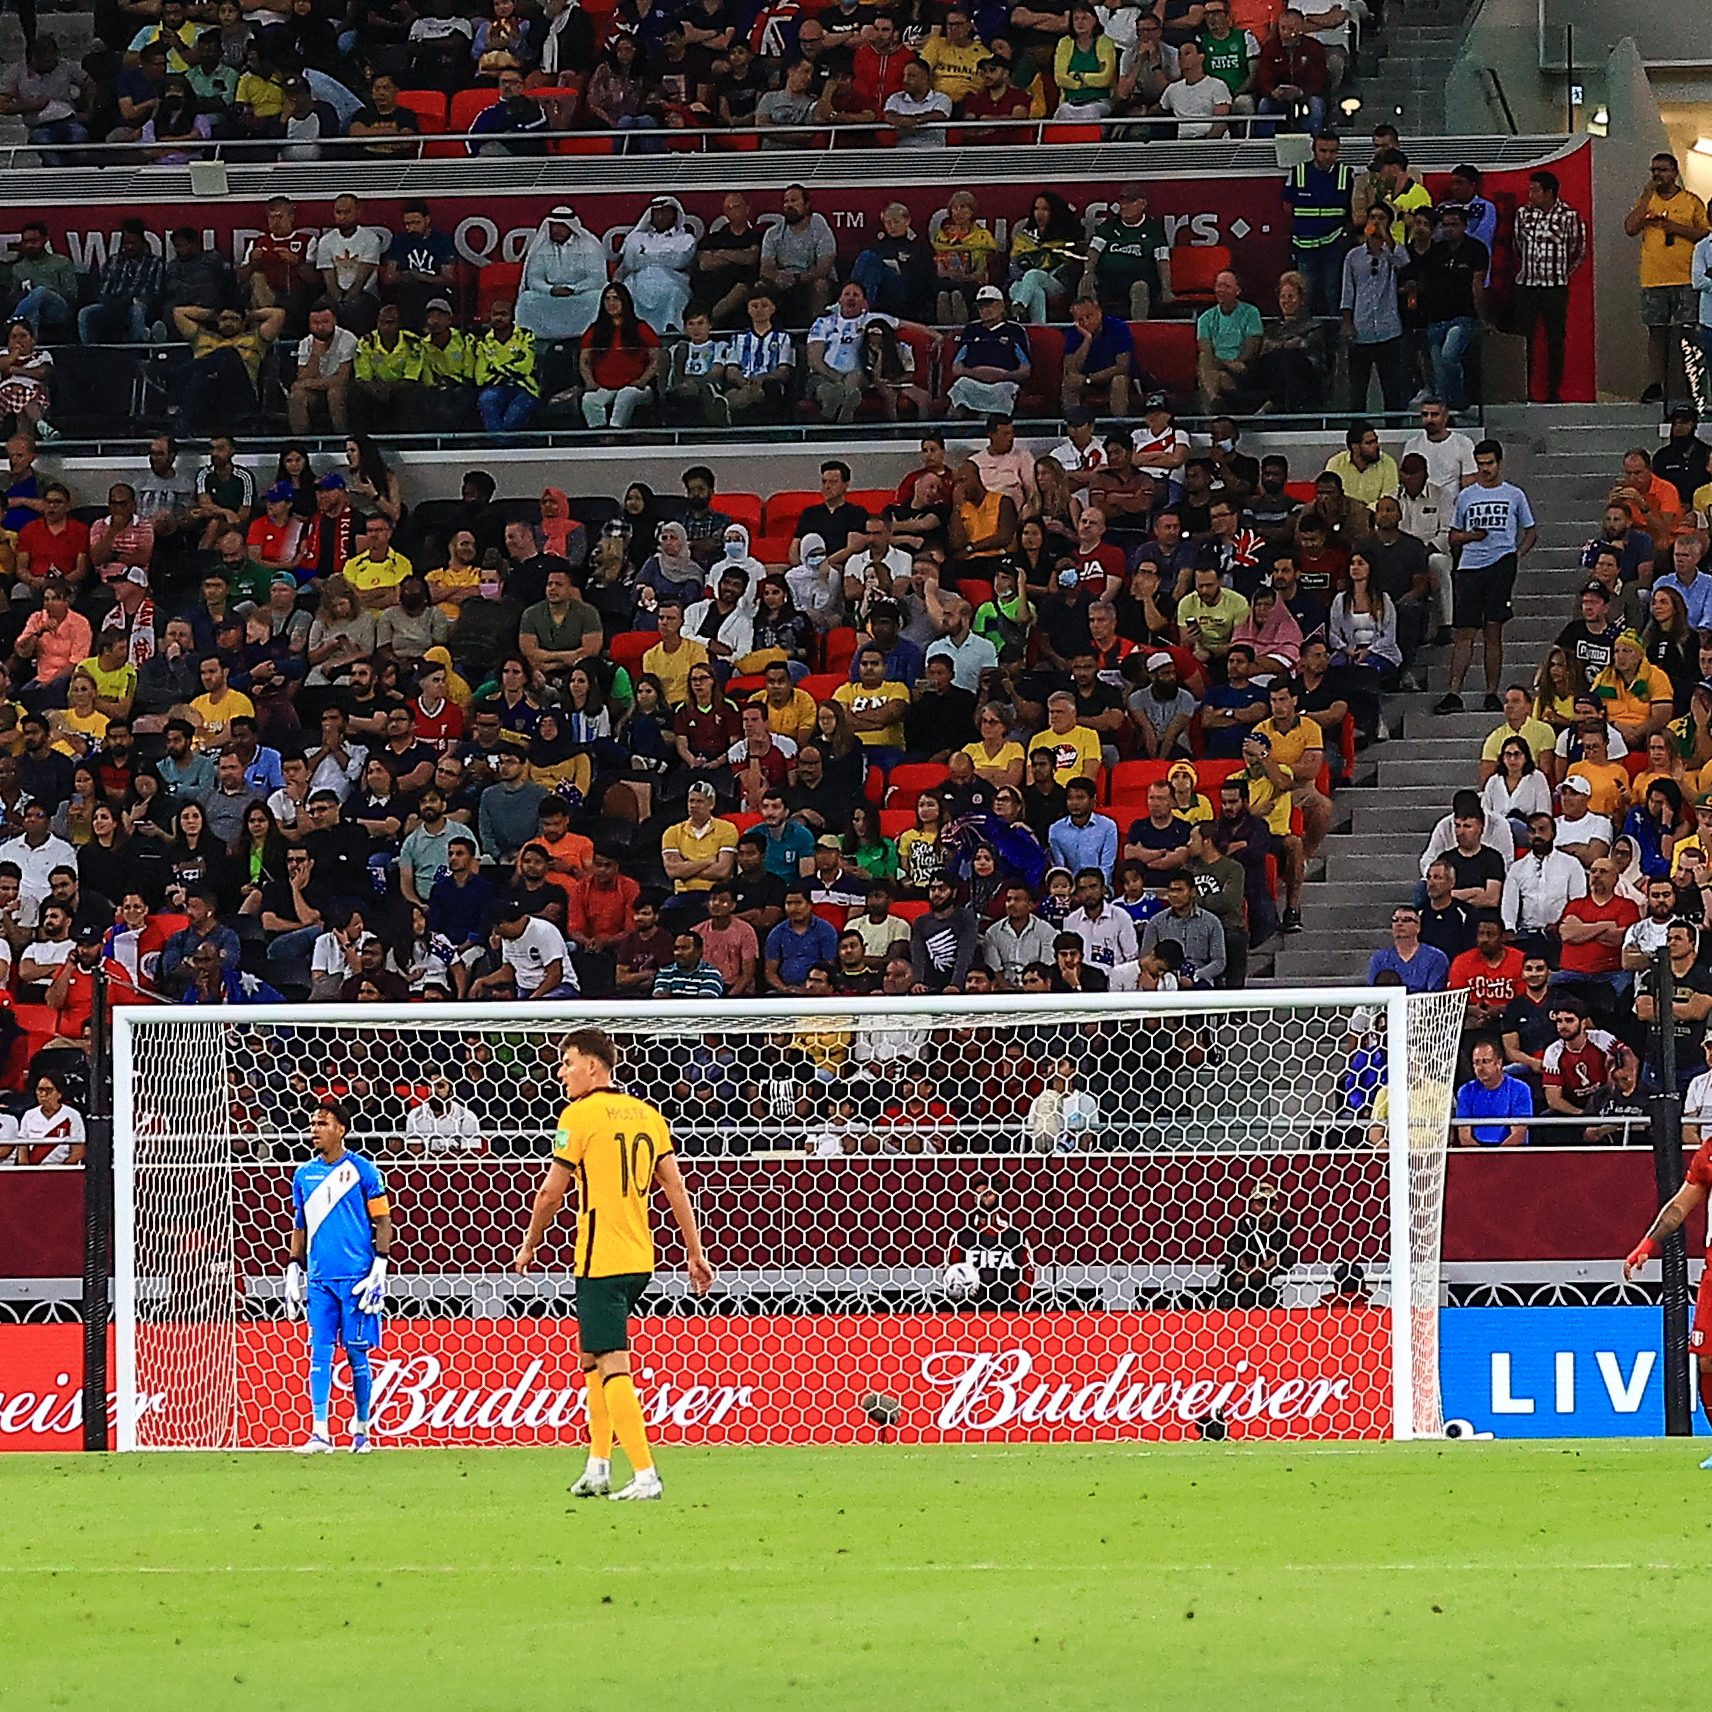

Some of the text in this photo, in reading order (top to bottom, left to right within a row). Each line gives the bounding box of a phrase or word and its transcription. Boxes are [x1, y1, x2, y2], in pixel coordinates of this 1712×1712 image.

[1468, 505, 1509, 517] BLACK
[1468, 516, 1507, 528] FOREST
[614, 1132, 655, 1199] 10
[965, 1249, 1016, 1269] FIFA
[920, 1348, 1350, 1431] Budweiser
